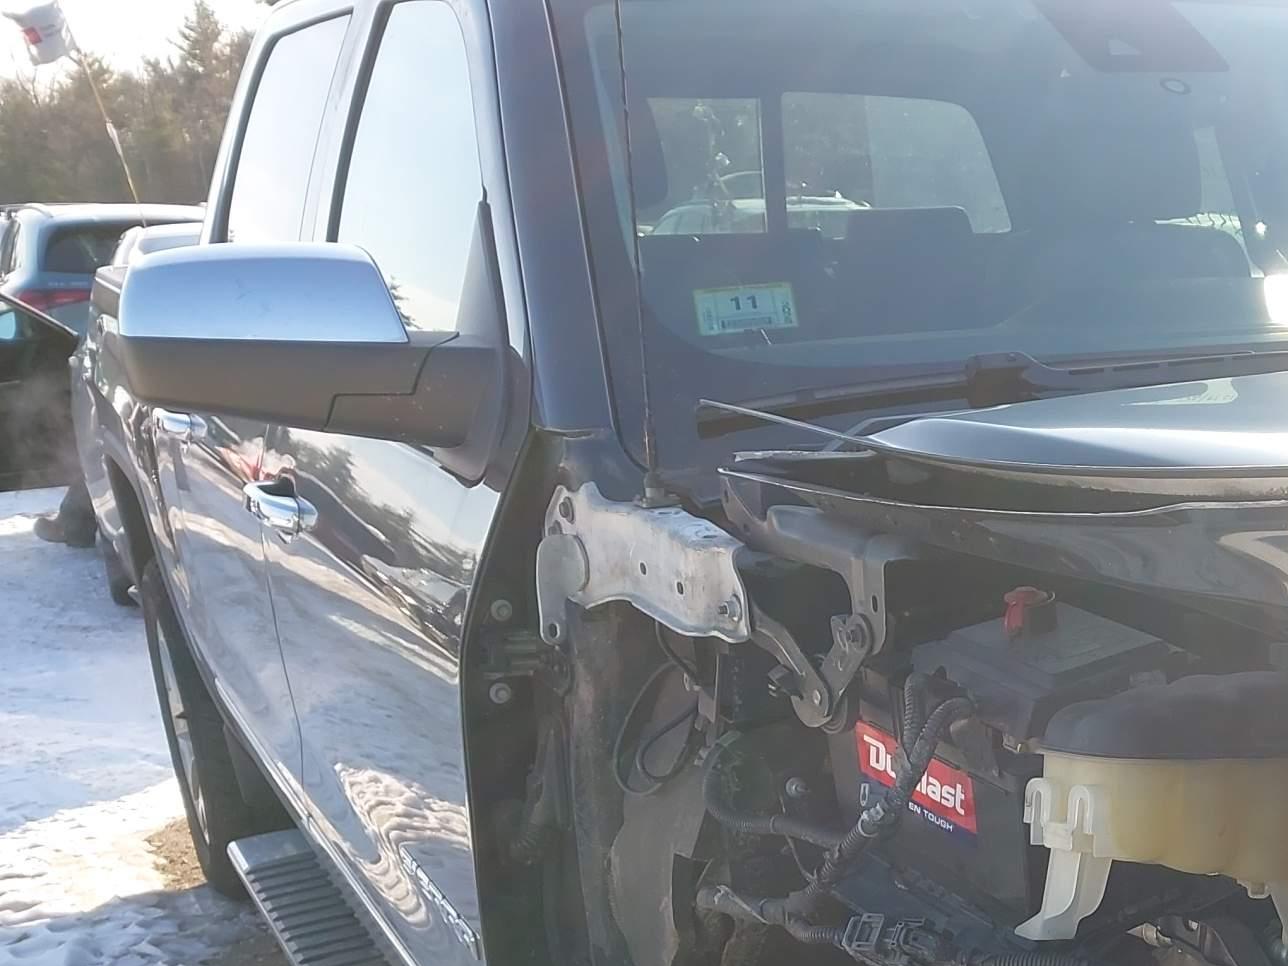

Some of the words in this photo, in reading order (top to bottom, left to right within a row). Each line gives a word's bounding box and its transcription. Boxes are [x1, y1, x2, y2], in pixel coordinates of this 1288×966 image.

[729, 295, 758, 311] 11
[863, 734, 965, 816] Dulast
[923, 810, 954, 832] TOUGH
